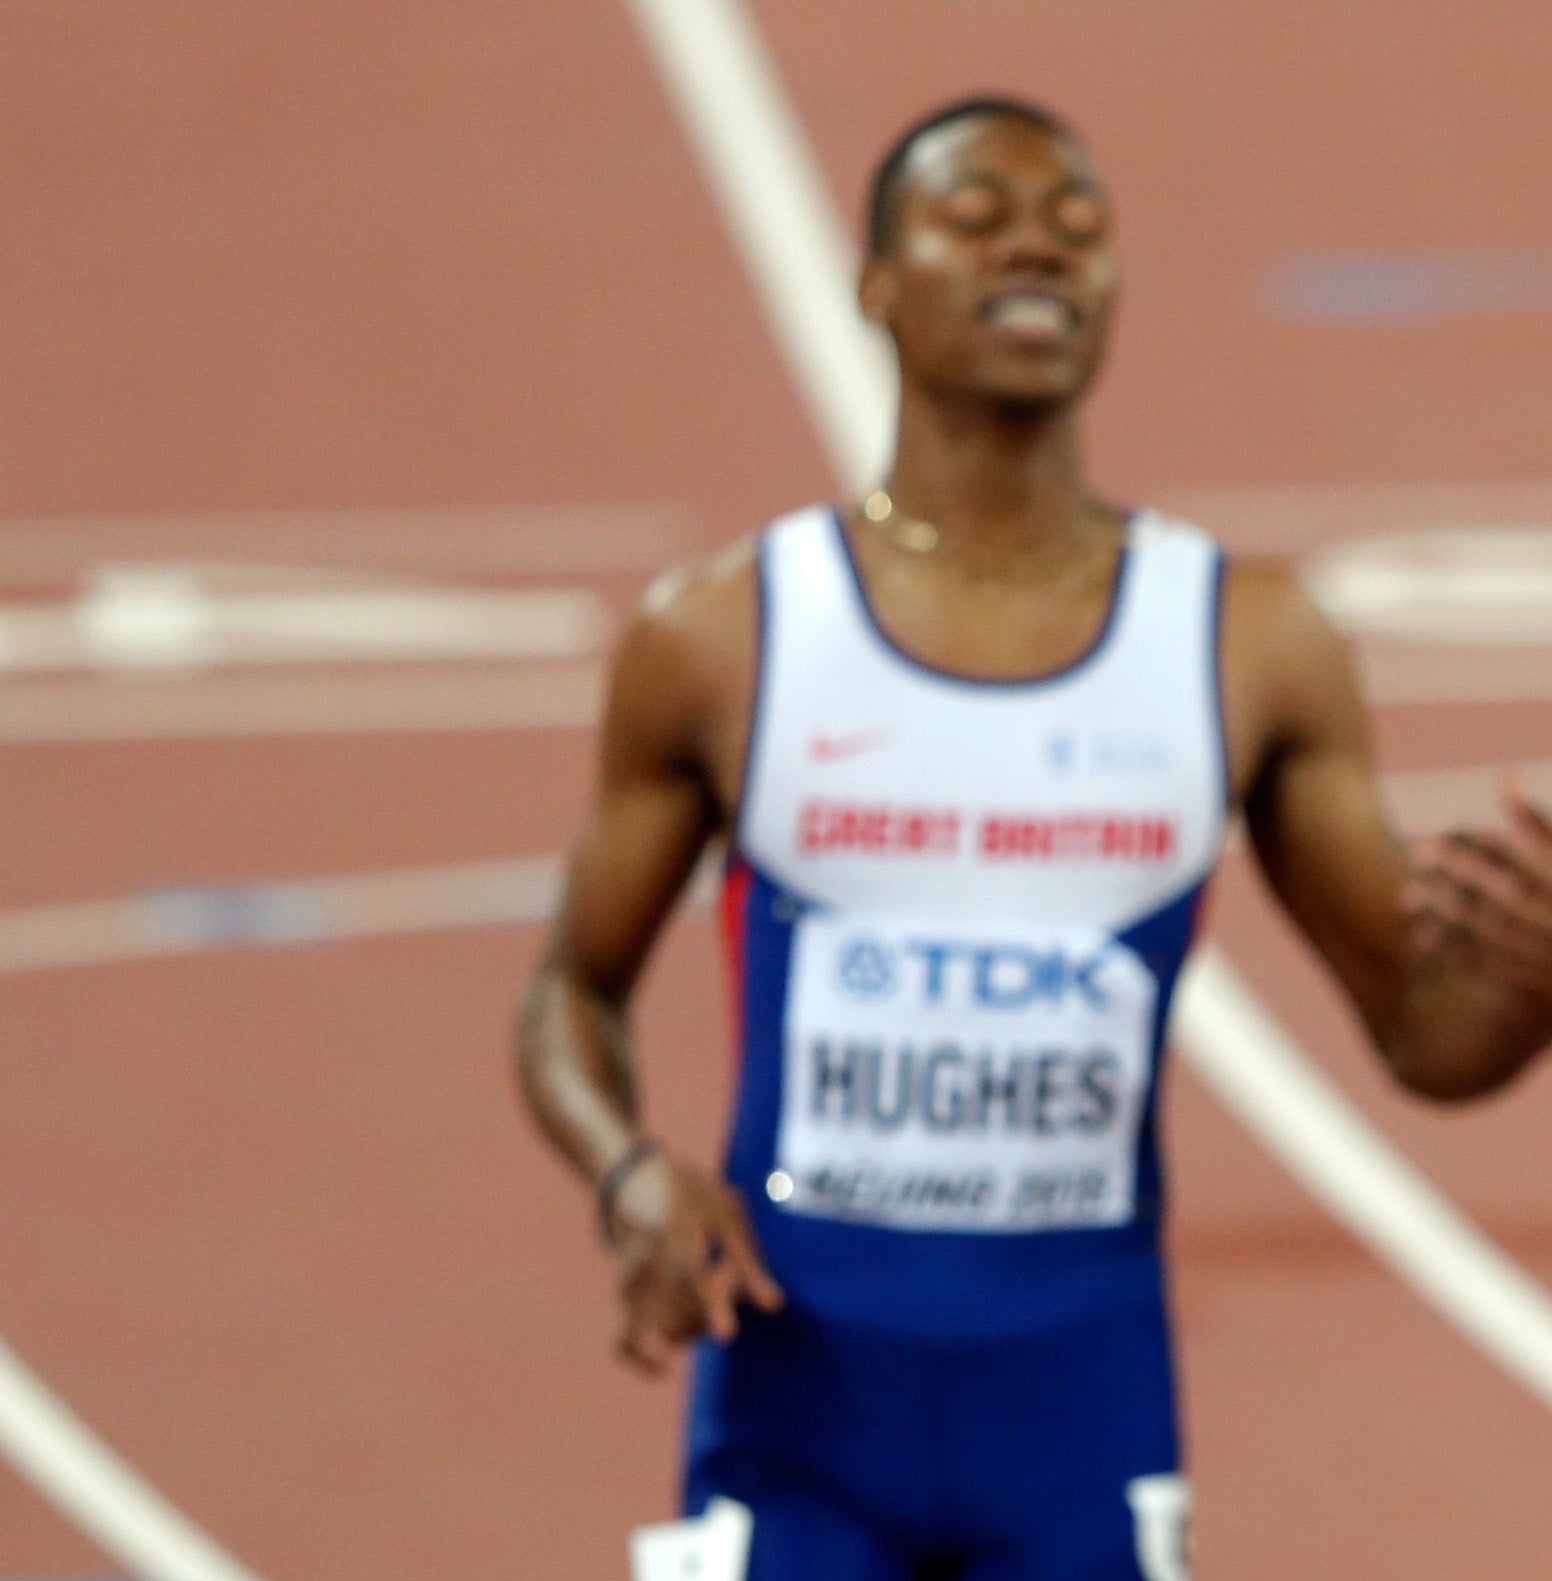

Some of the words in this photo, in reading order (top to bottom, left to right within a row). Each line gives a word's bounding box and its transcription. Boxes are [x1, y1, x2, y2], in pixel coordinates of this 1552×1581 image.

[800, 800, 960, 853] GREAT
[981, 812, 1176, 858] BRITAIN
[906, 940, 1112, 1004] TDK
[810, 1041, 1120, 1135] HUGHES
